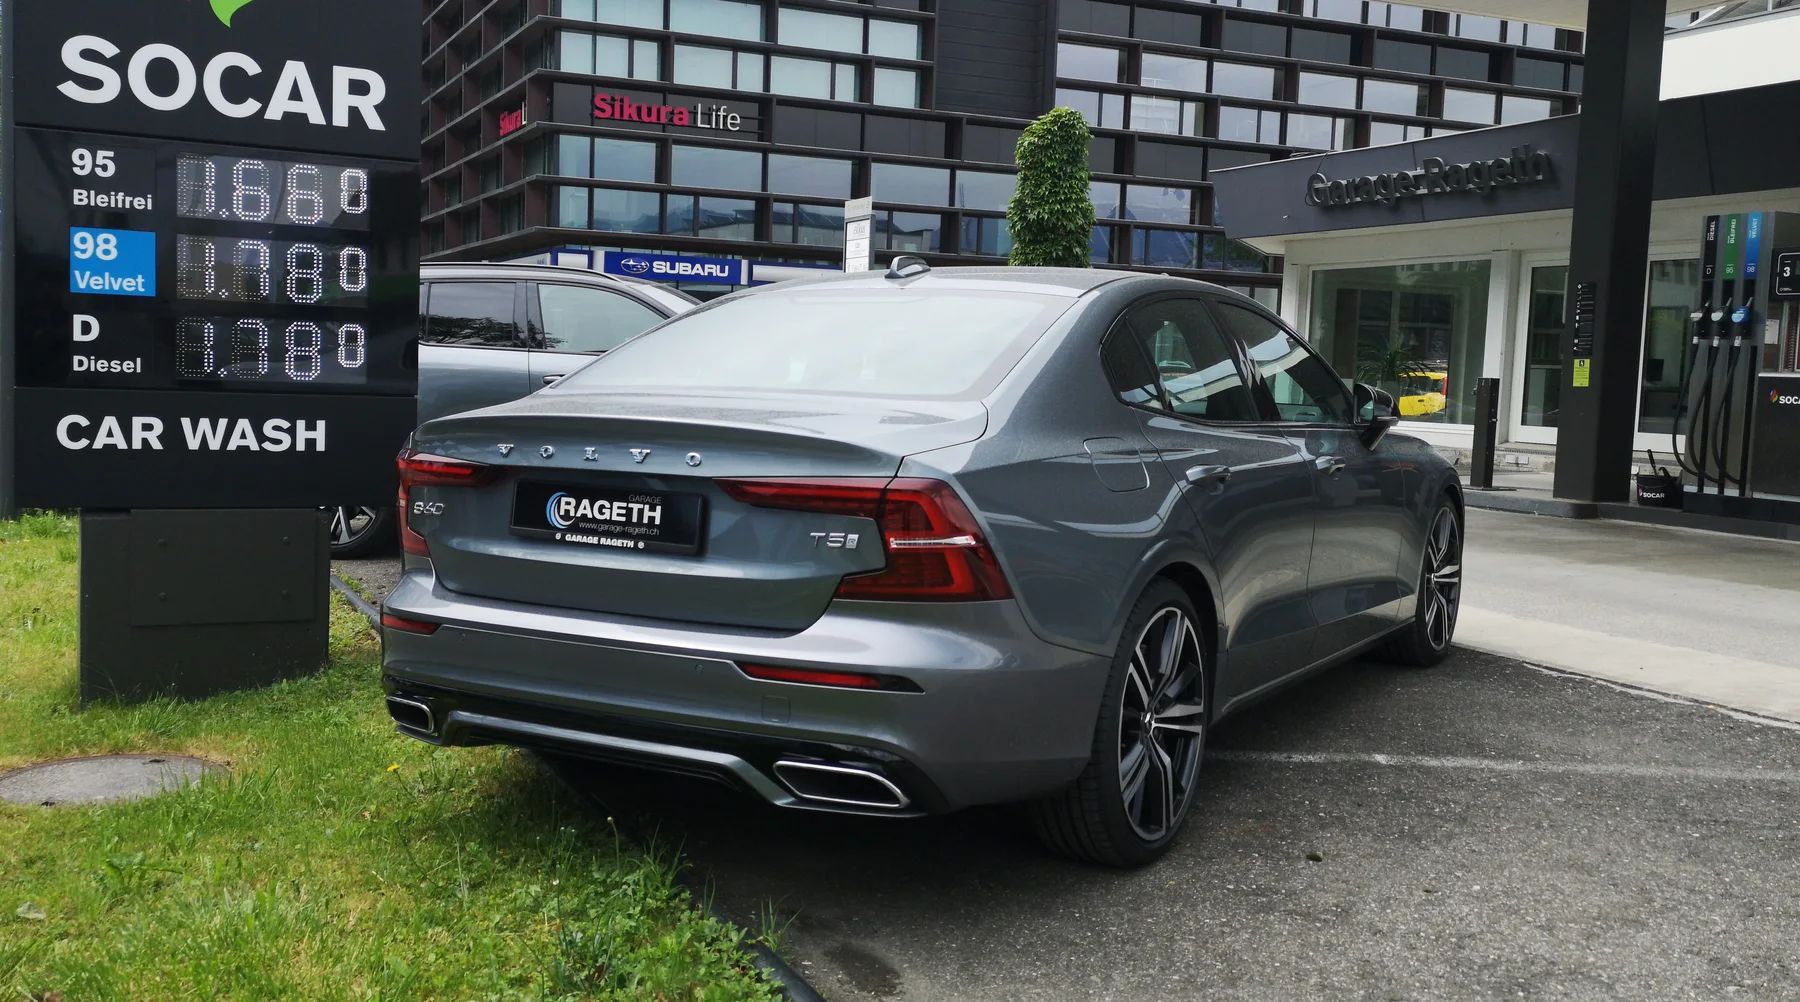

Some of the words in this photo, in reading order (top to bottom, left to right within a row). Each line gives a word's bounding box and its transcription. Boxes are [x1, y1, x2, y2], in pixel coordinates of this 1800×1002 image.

[56, 34, 387, 131] SOCAR
[593, 93, 689, 126] Sikura
[697, 102, 741, 131] Life
[71, 148, 116, 178] 95
[1308, 171, 1415, 208] Garage
[1423, 143, 1548, 197] Rageth
[73, 188, 153, 211] Bleifrei
[73, 231, 118, 261] 98
[652, 260, 729, 278] SUBARU
[1783, 266, 1791, 277] 3
[74, 270, 145, 292] Velvet
[72, 314, 100, 342] D
[72, 355, 142, 374] Diesel
[56, 414, 164, 450] CAR
[180, 417, 326, 452] WASH
[497, 444, 702, 467] VOLVO
[628, 494, 662, 504] GARAGE
[1642, 491, 1665, 499] SOCAR
[413, 501, 445, 515] S60
[559, 497, 661, 525] RAGETH
[578, 522, 660, 535] www.garage-rageth.ch
[565, 534, 598, 544] GARAGE
[600, 538, 634, 548] RAGETH
[810, 532, 845, 549] T5
